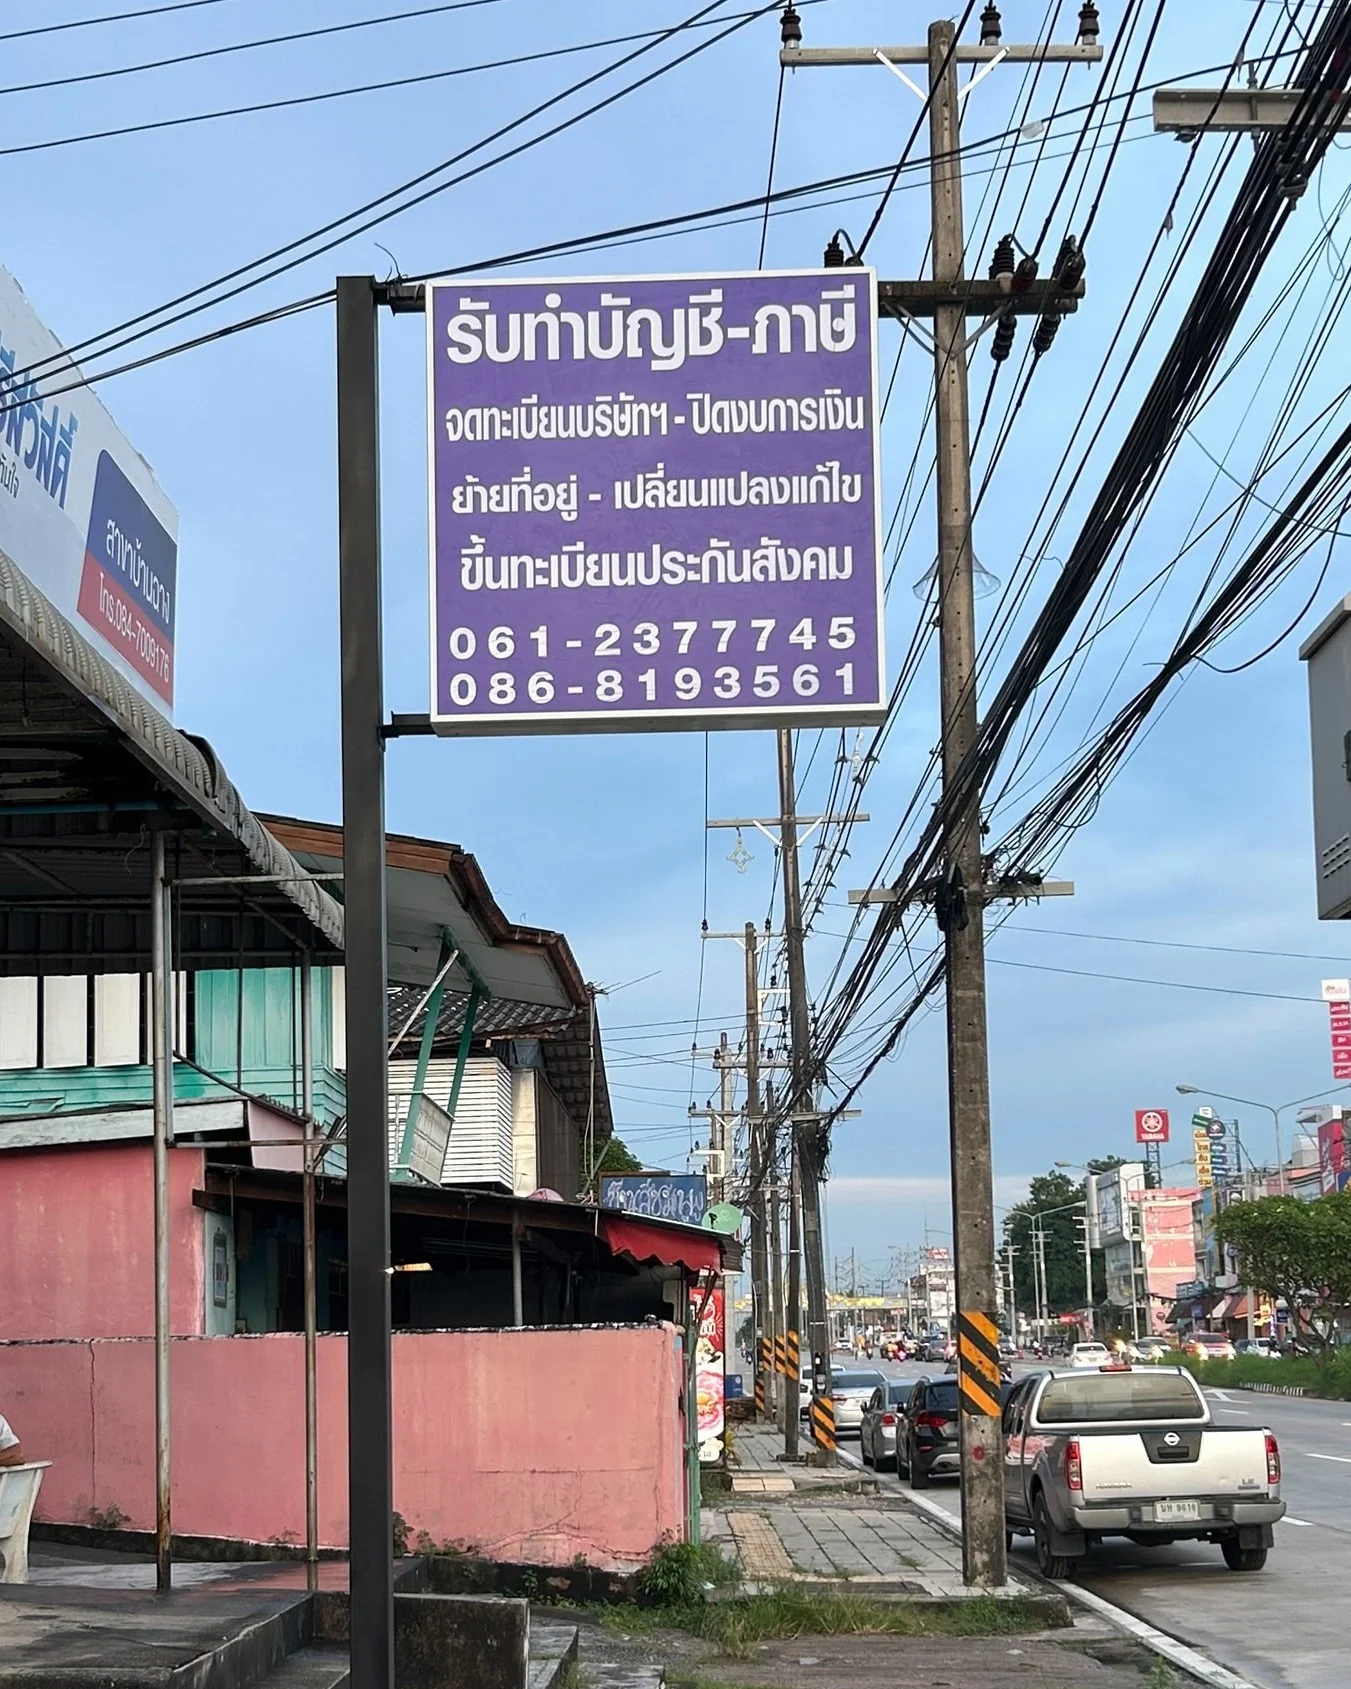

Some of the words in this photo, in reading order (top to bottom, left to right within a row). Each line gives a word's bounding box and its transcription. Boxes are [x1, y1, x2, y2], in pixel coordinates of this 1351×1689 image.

[446, 283, 856, 370] รับทำบัญชี-ภาษี
[445, 391, 668, 442] จดทะเบียนบริษัทฯ
[686, 389, 864, 435] ปิดงบการเงิน
[452, 466, 577, 521] ย้ายที่อยู่
[614, 461, 862, 510] เปลี่ยนแปลงแก้ไข
[460, 534, 853, 591] ขึ้นทะเบียนประกันสังคม
[98, 571, 170, 684] โทร.084-7009176
[449, 616, 856, 660] 061-2377745
[449, 662, 855, 706] 086-8193561
